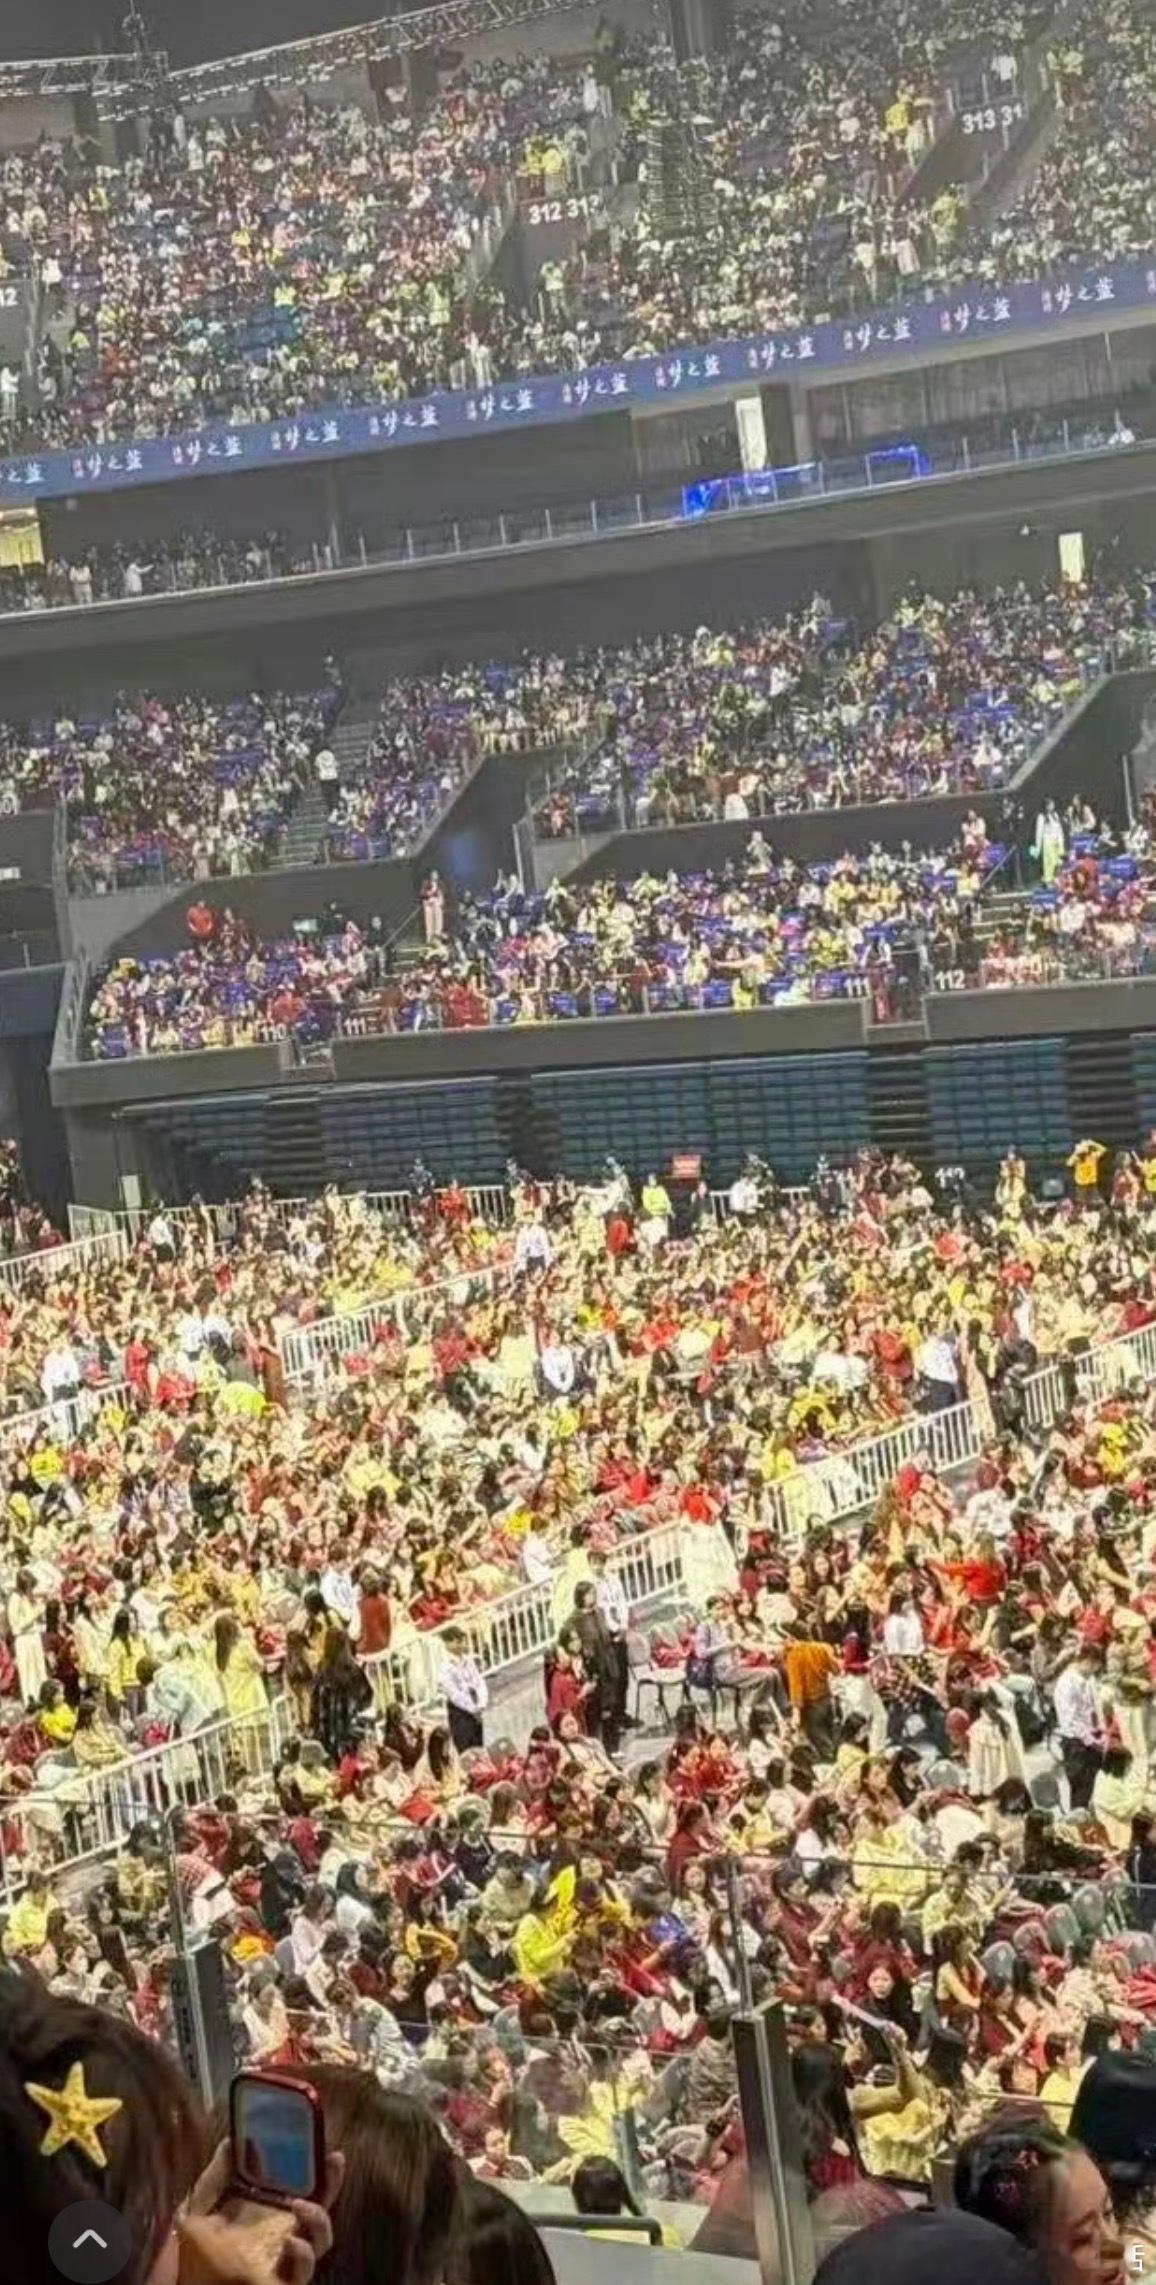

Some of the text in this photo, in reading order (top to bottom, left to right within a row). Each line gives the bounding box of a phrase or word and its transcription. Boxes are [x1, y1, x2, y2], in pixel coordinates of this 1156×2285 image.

[962, 108, 996, 134] 313
[528, 201, 562, 225] 312
[0, 460, 46, 484] 之蓝
[935, 969, 966, 990] 112
[344, 1017, 367, 1036] 111
